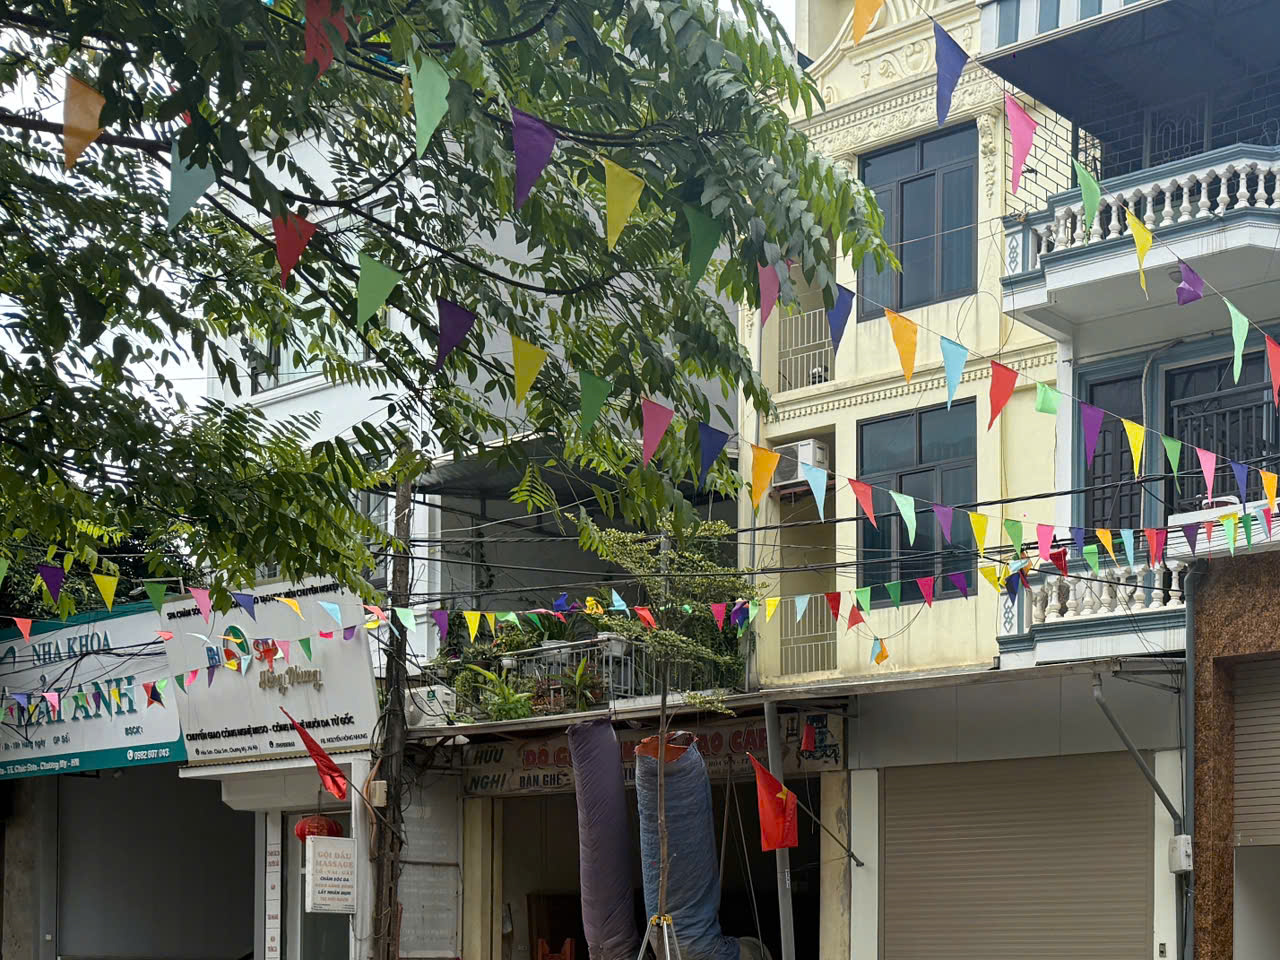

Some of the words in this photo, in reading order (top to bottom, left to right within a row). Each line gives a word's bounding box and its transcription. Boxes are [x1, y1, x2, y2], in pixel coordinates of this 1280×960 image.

[32, 639, 63, 666] NHA
[67, 630, 113, 657] KHOA
[72, 675, 138, 721] ANH
[473, 743, 504, 765] HỮU
[315, 860, 353, 868] MASSAGE
